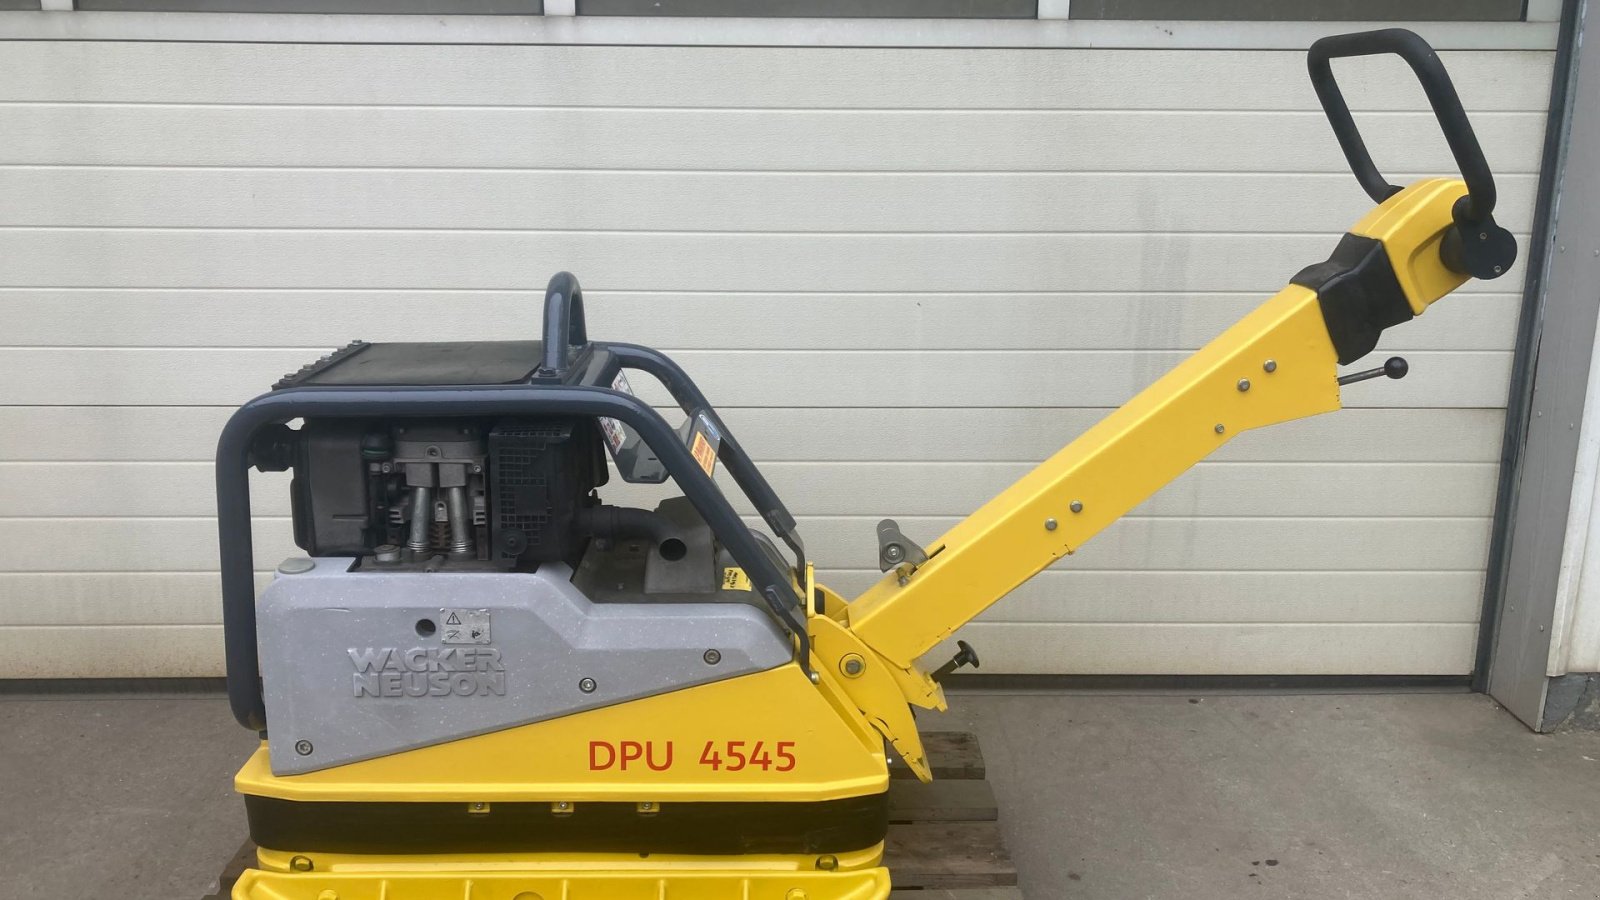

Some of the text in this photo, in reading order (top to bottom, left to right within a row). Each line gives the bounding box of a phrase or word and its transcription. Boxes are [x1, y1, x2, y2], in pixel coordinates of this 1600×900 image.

[348, 648, 506, 673] WACKER
[353, 673, 506, 697] NEUSON
[589, 741, 796, 771] DPU 4545
